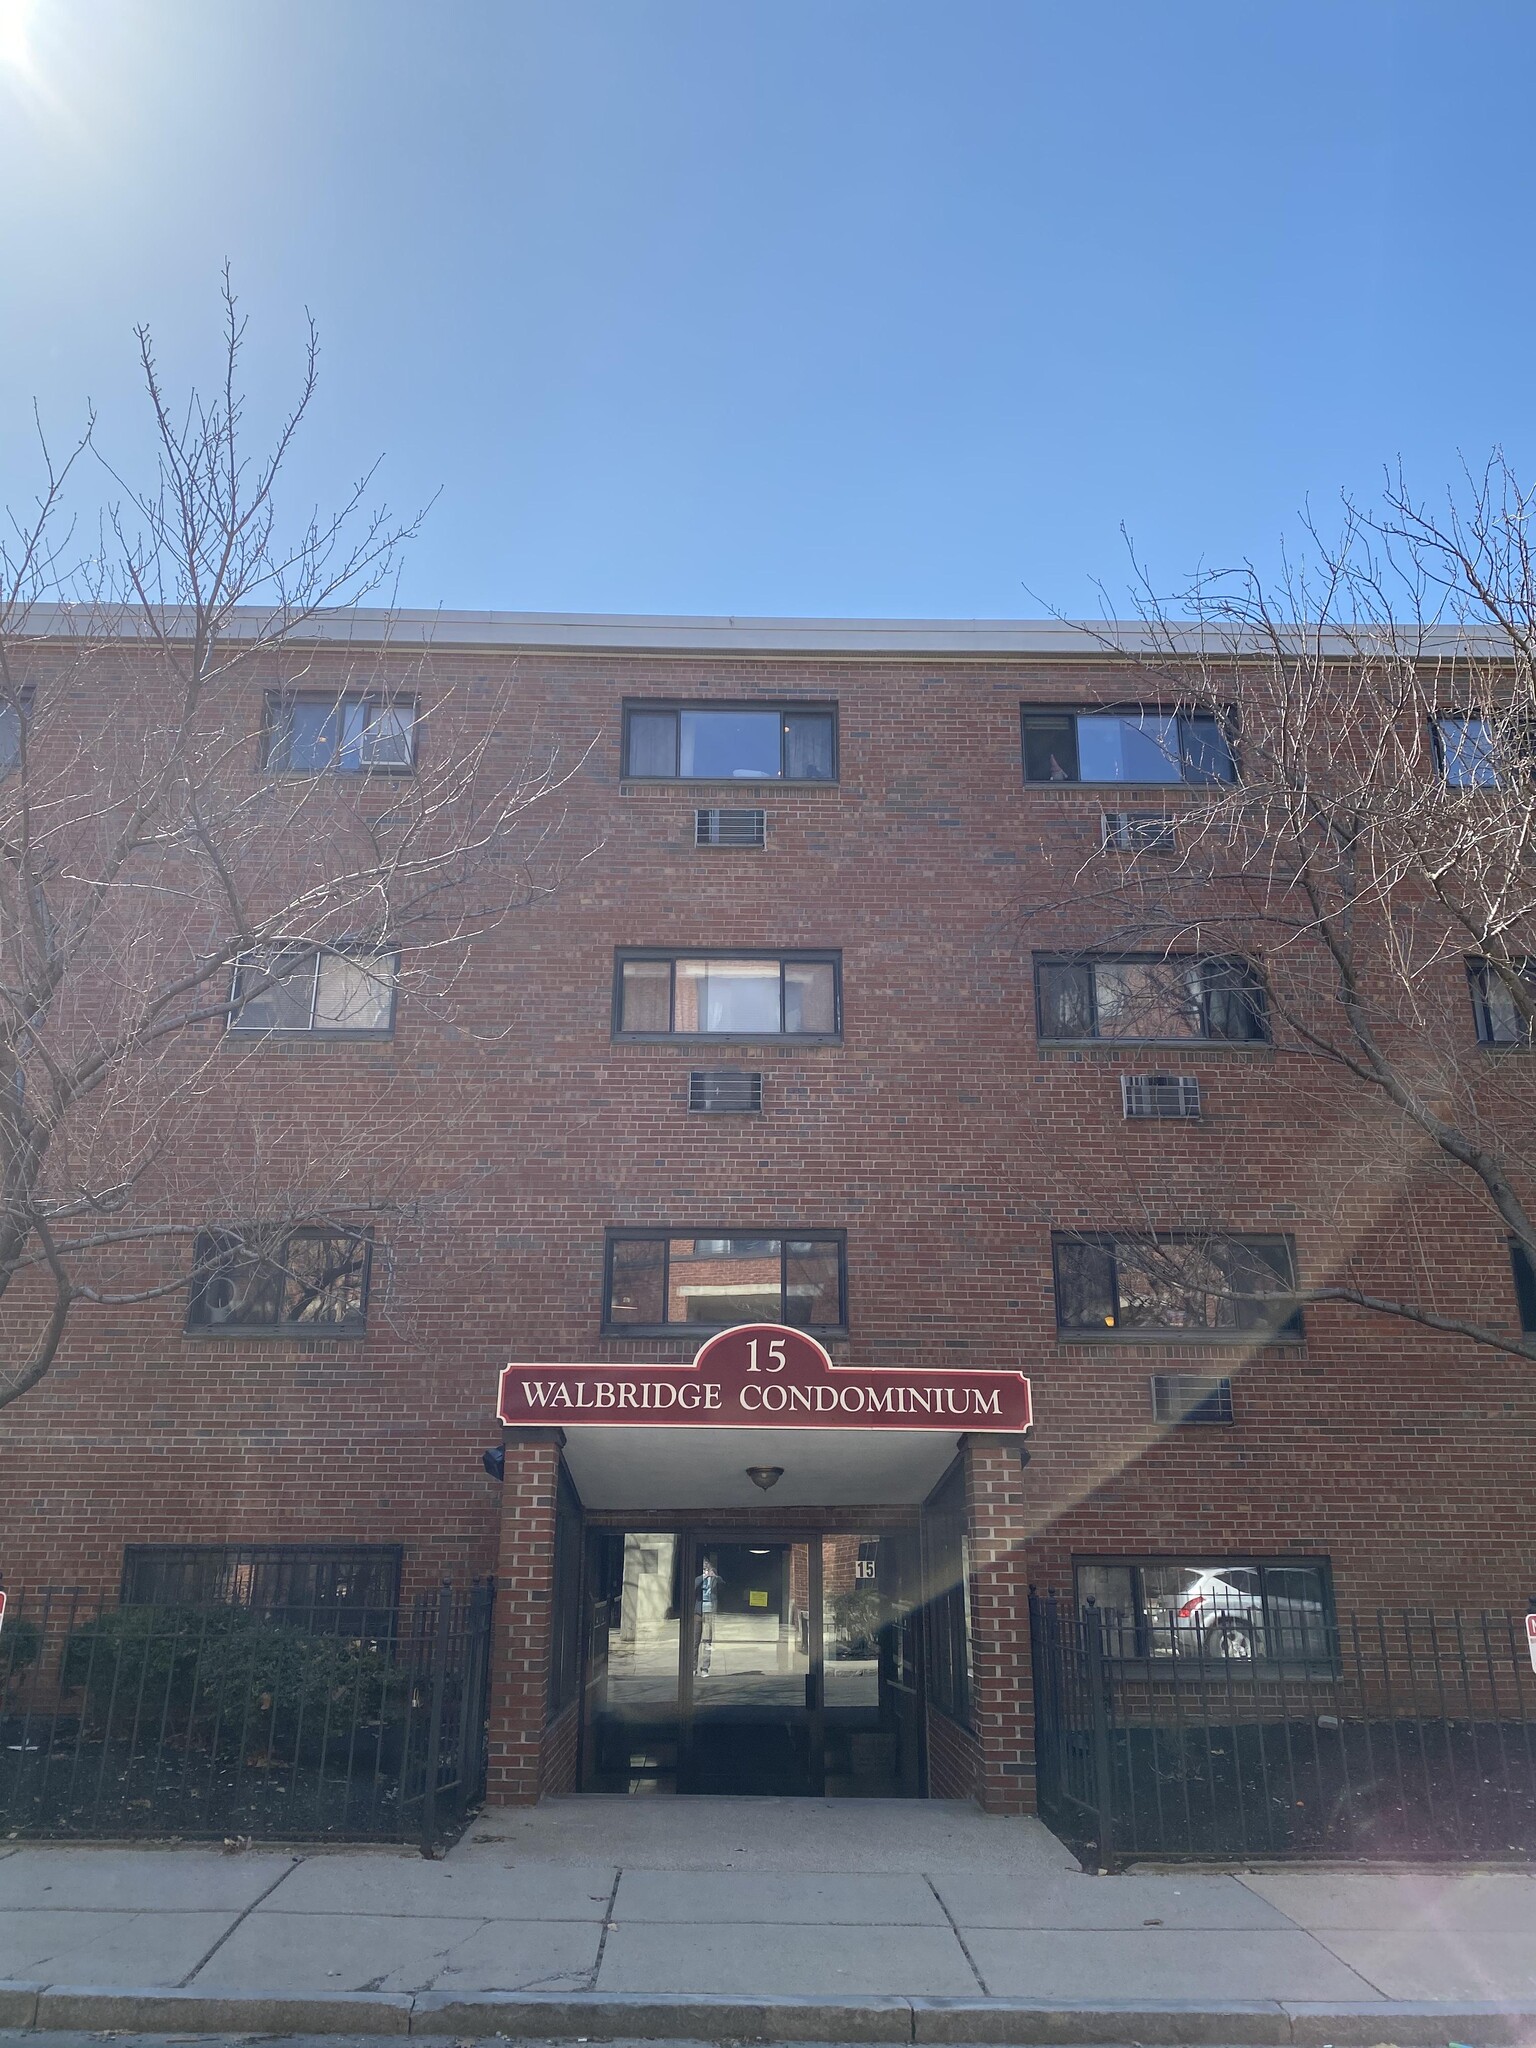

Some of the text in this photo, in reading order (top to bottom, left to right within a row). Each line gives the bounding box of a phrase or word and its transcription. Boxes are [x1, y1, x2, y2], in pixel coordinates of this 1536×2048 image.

[746, 1338, 787, 1373] 15
[521, 1381, 1003, 1415] WALBRIDGE CONDOMINIUM
[857, 1561, 874, 1578] 15
